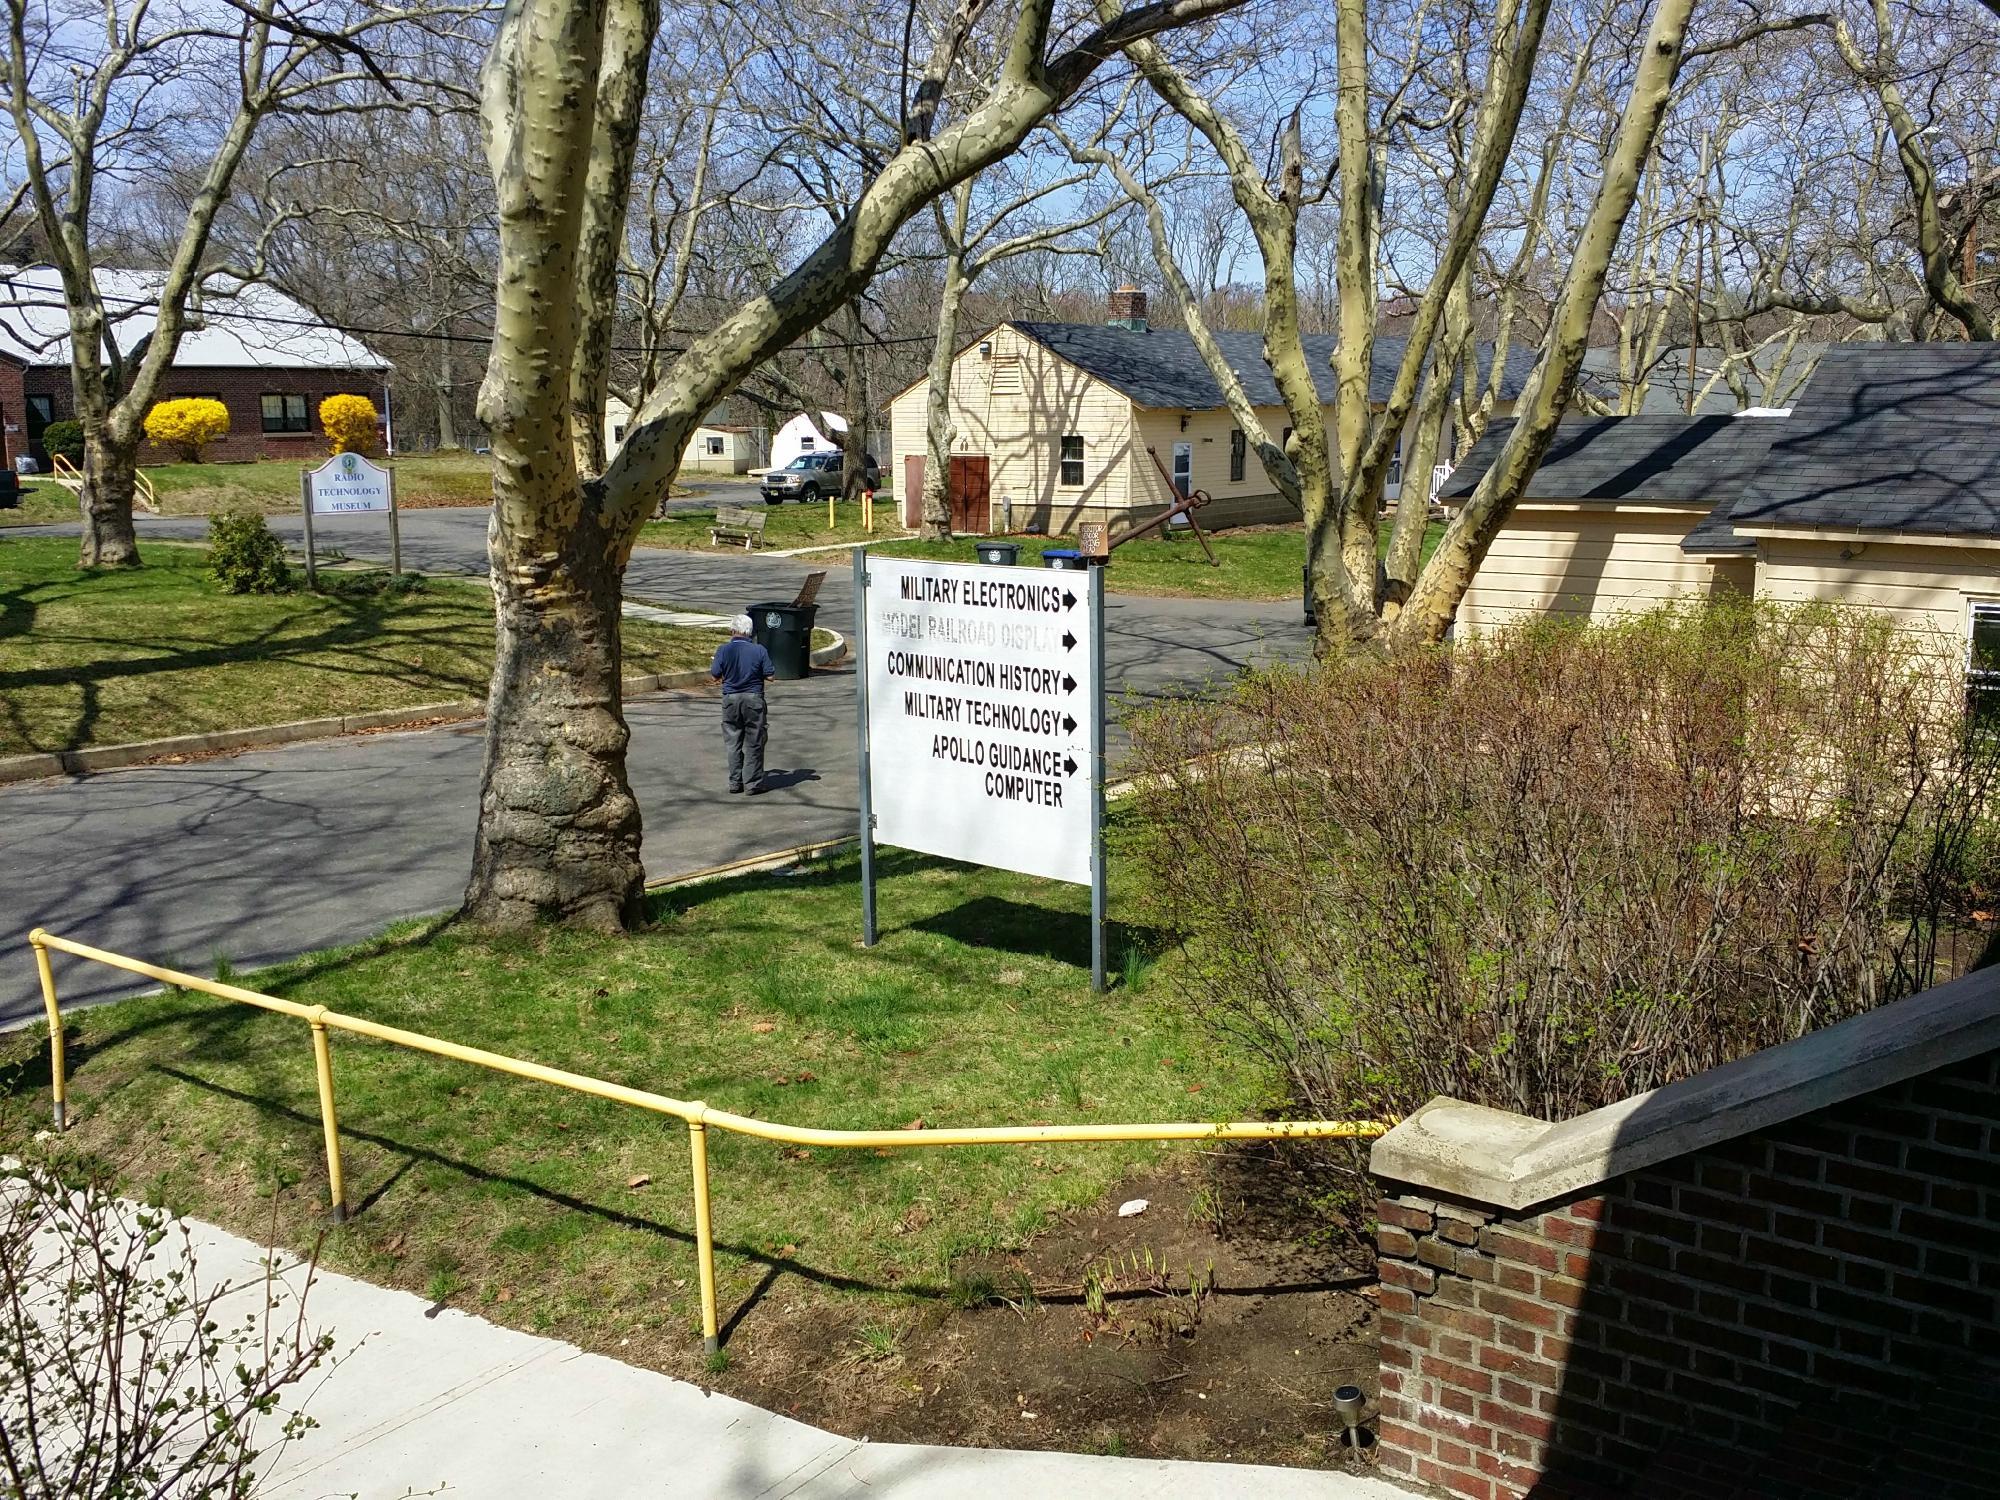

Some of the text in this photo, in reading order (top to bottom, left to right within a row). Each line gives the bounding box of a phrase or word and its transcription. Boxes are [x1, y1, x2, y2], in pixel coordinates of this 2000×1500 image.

[318, 487, 381, 497] TECHNOLOGY
[334, 473, 364, 482] RADIO
[331, 502, 371, 510] MUSEUM
[901, 576, 1060, 613] MILITARY ELECTRONICS
[928, 615, 996, 647] RAILROAD
[888, 651, 1061, 696] COMMUNICATION HISTORY
[904, 691, 1061, 736] MILITARY TECHNOLOGY
[932, 734, 1062, 778] APOLLO GUIDANCE
[985, 772, 1063, 808] COMPUTER
